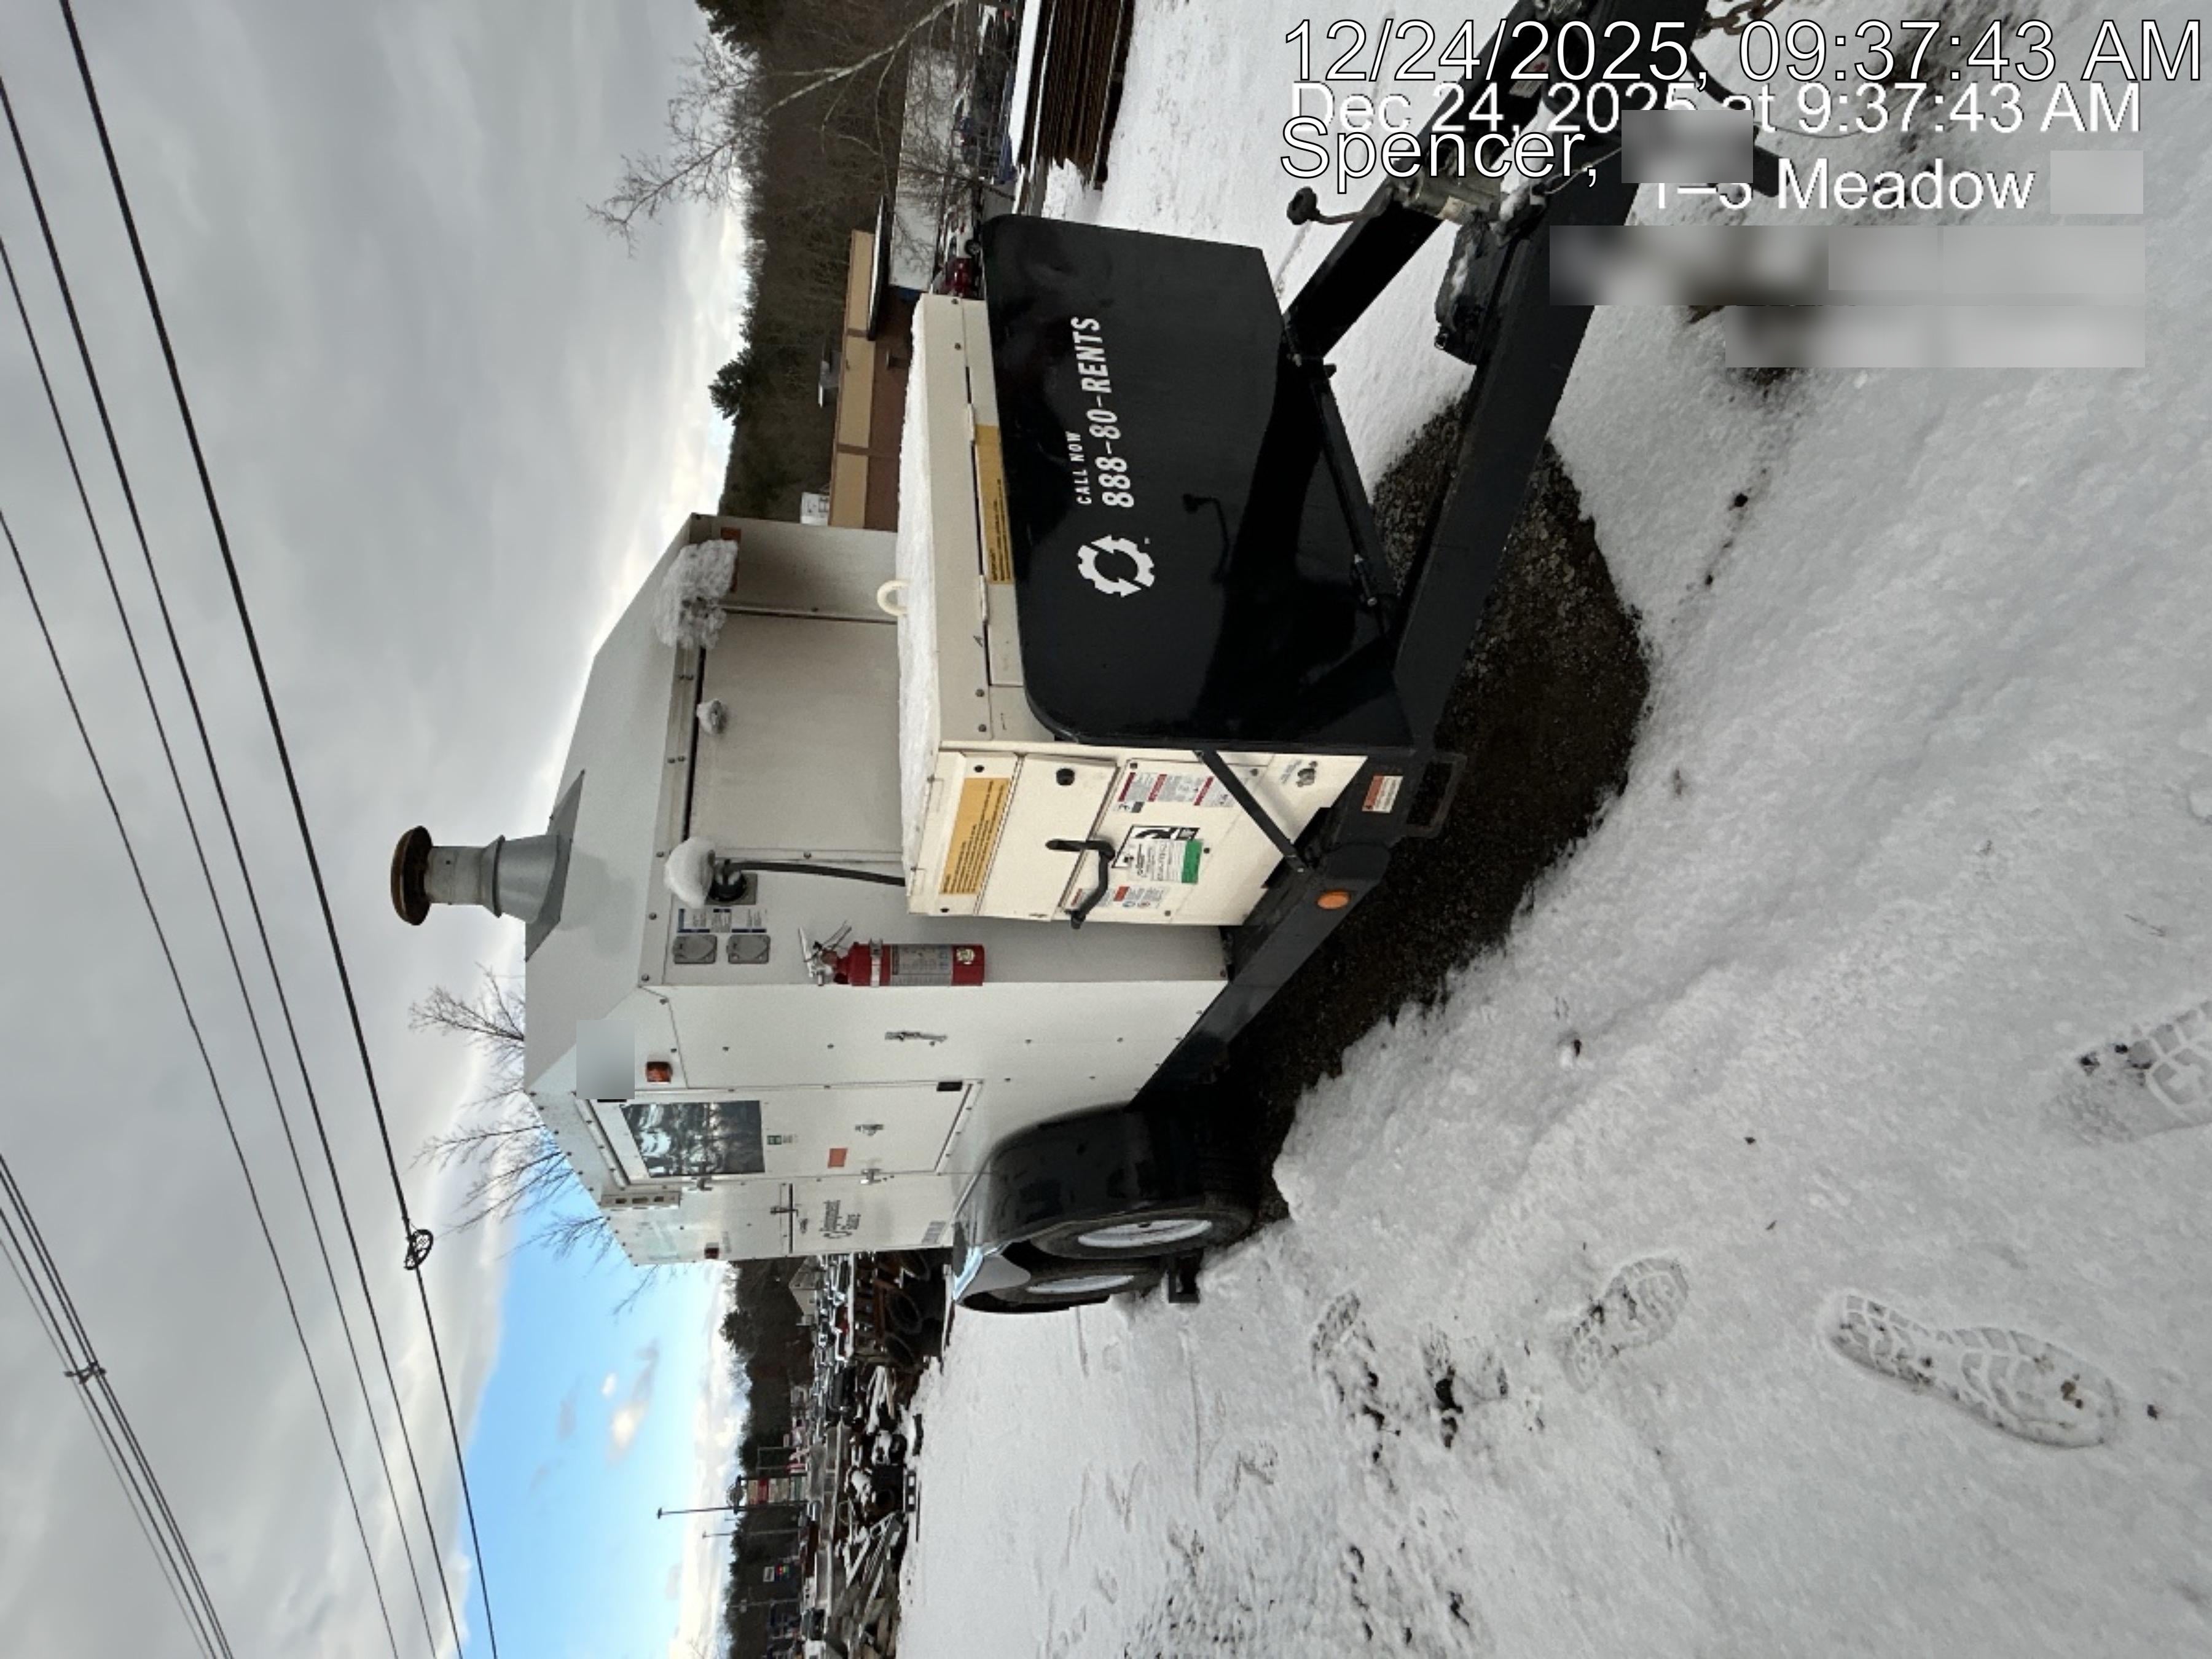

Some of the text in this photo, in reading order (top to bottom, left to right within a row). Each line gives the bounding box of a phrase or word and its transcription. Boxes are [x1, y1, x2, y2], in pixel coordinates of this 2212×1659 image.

[1064, 431, 1092, 505] CALL NOW
[1070, 316, 1135, 508] 888-80-RENTS
